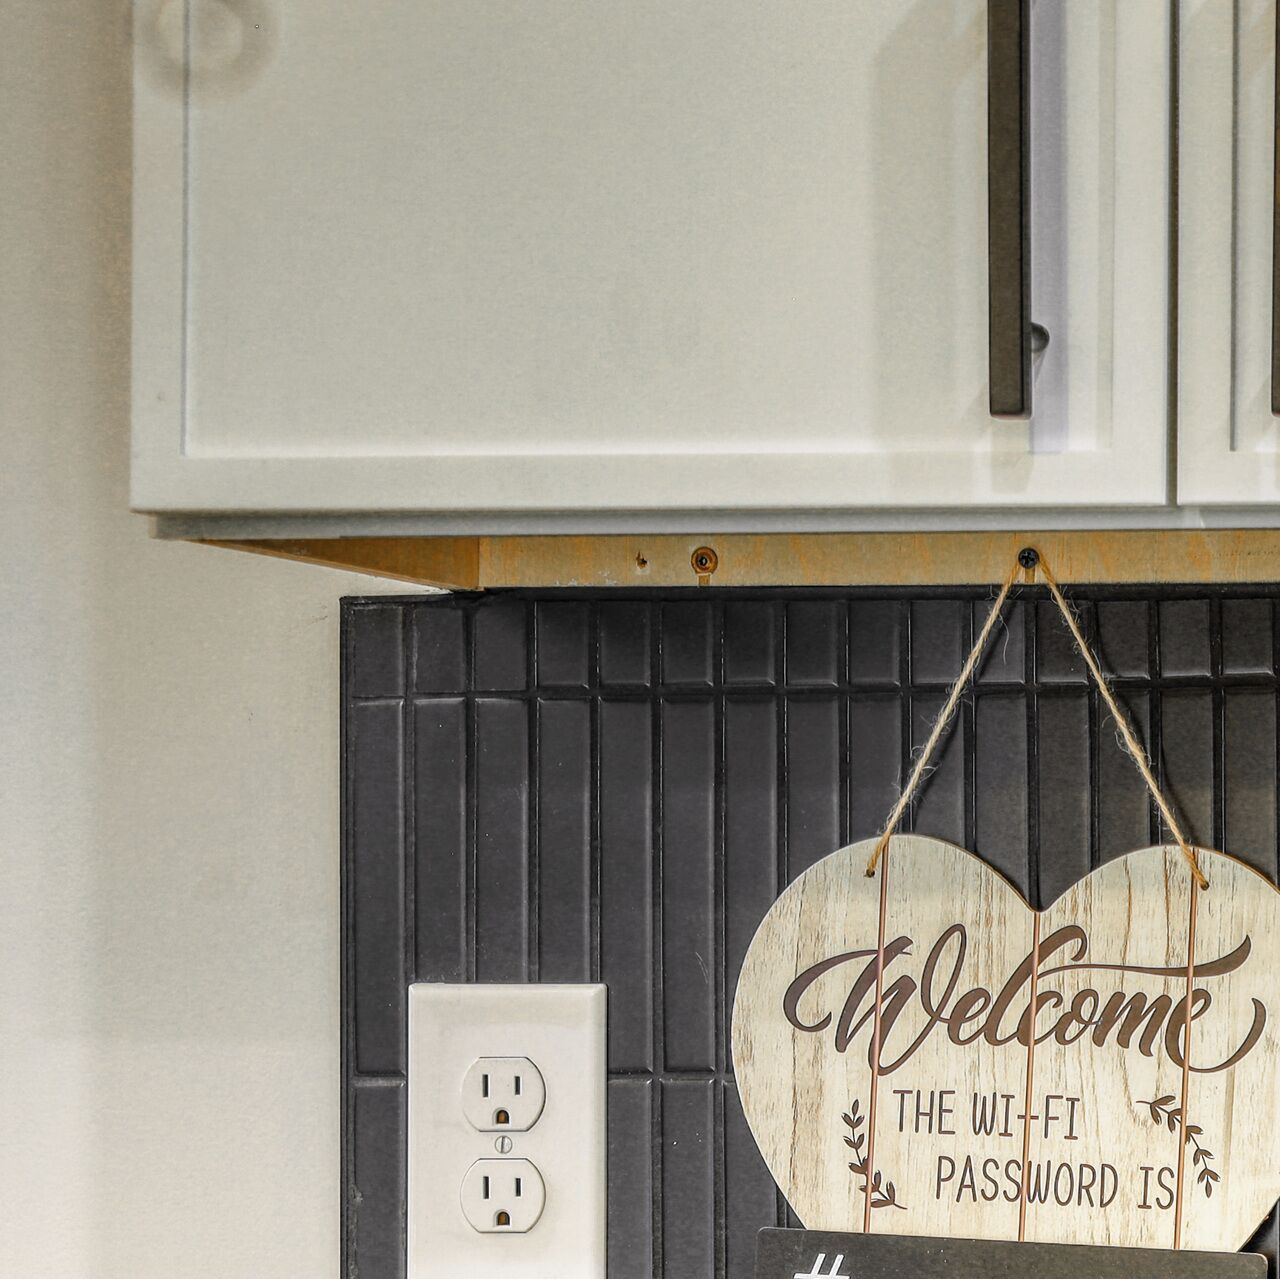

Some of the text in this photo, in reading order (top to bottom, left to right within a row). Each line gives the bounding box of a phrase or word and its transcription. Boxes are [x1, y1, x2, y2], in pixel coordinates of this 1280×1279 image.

[782, 924, 1266, 1076] Welcome
[893, 1089, 1081, 1141] THE WI-FI
[935, 1154, 1176, 1210] PASSWORD IS
